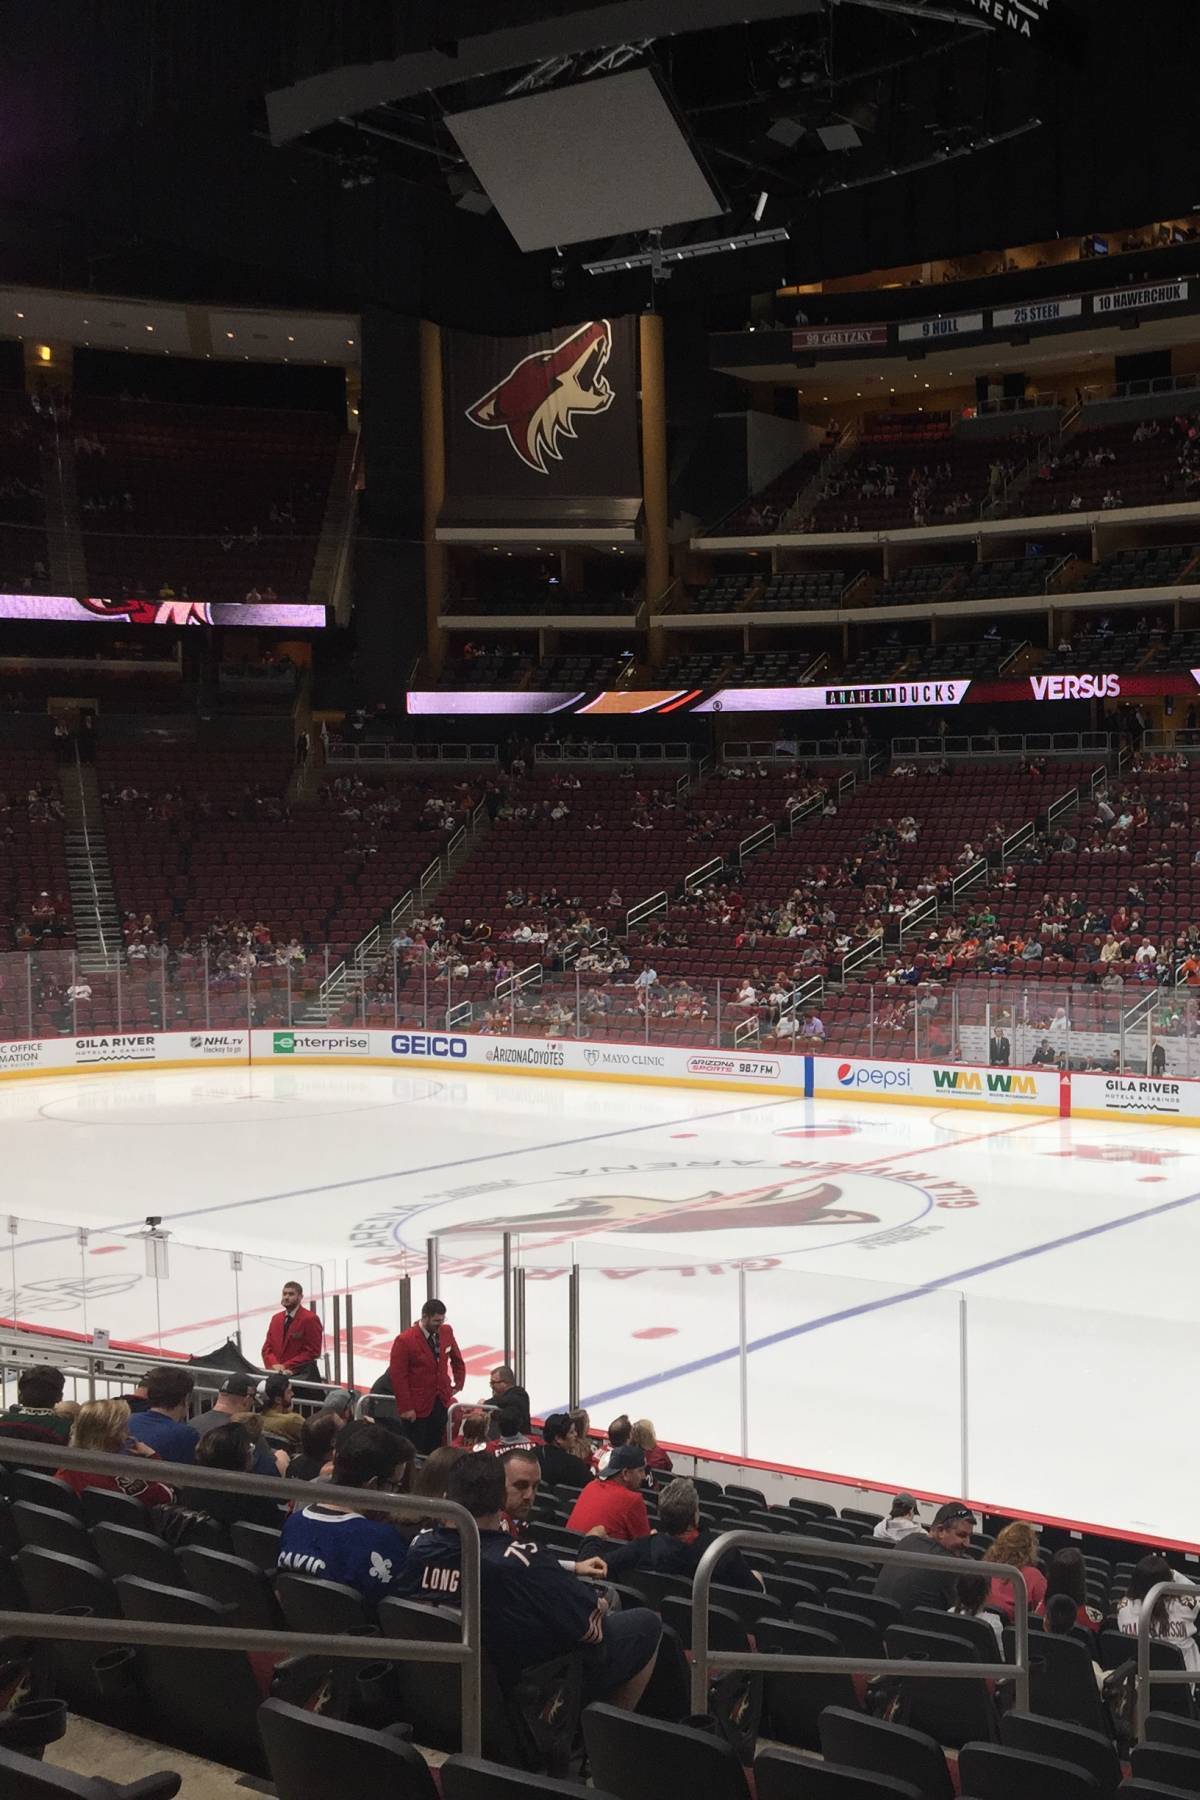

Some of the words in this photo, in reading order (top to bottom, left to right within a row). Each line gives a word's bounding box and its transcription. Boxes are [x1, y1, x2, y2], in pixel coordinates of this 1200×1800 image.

[970, 0, 1031, 37] RENA
[1100, 296, 1111, 310] 10
[1113, 286, 1181, 309] HAWERCHUK
[1013, 308, 1027, 323] 25
[1029, 303, 1060, 320] STEEN
[921, 322, 930, 336] 9
[933, 319, 958, 335] HULL
[806, 334, 819, 345] 99
[822, 331, 872, 345] GRETZKY
[829, 688, 895, 704] ANAHEIM
[900, 683, 955, 703] DUCKS
[1030, 674, 1120, 700] VERSUS
[10, 1042, 43, 1053] OFFICE
[76, 1038, 109, 1049] GILA
[113, 1036, 155, 1047] RIVER
[275, 1035, 368, 1050] enterprise
[391, 1034, 467, 1058] GEICO
[603, 1053, 630, 1065] MAYO
[632, 1055, 665, 1066] CLINIC
[691, 1059, 734, 1067] ARIZONA
[739, 1063, 758, 1073] 98.7
[760, 1065, 773, 1074] FM
[692, 1065, 733, 1073] SPORTS
[856, 1067, 911, 1089] pepsi
[932, 1070, 984, 1090] WM
[986, 1074, 1038, 1094] WM
[1105, 1080, 1136, 1092] GILA
[1139, 1082, 1179, 1095] RIVER
[422, 1566, 460, 1593] LONG
